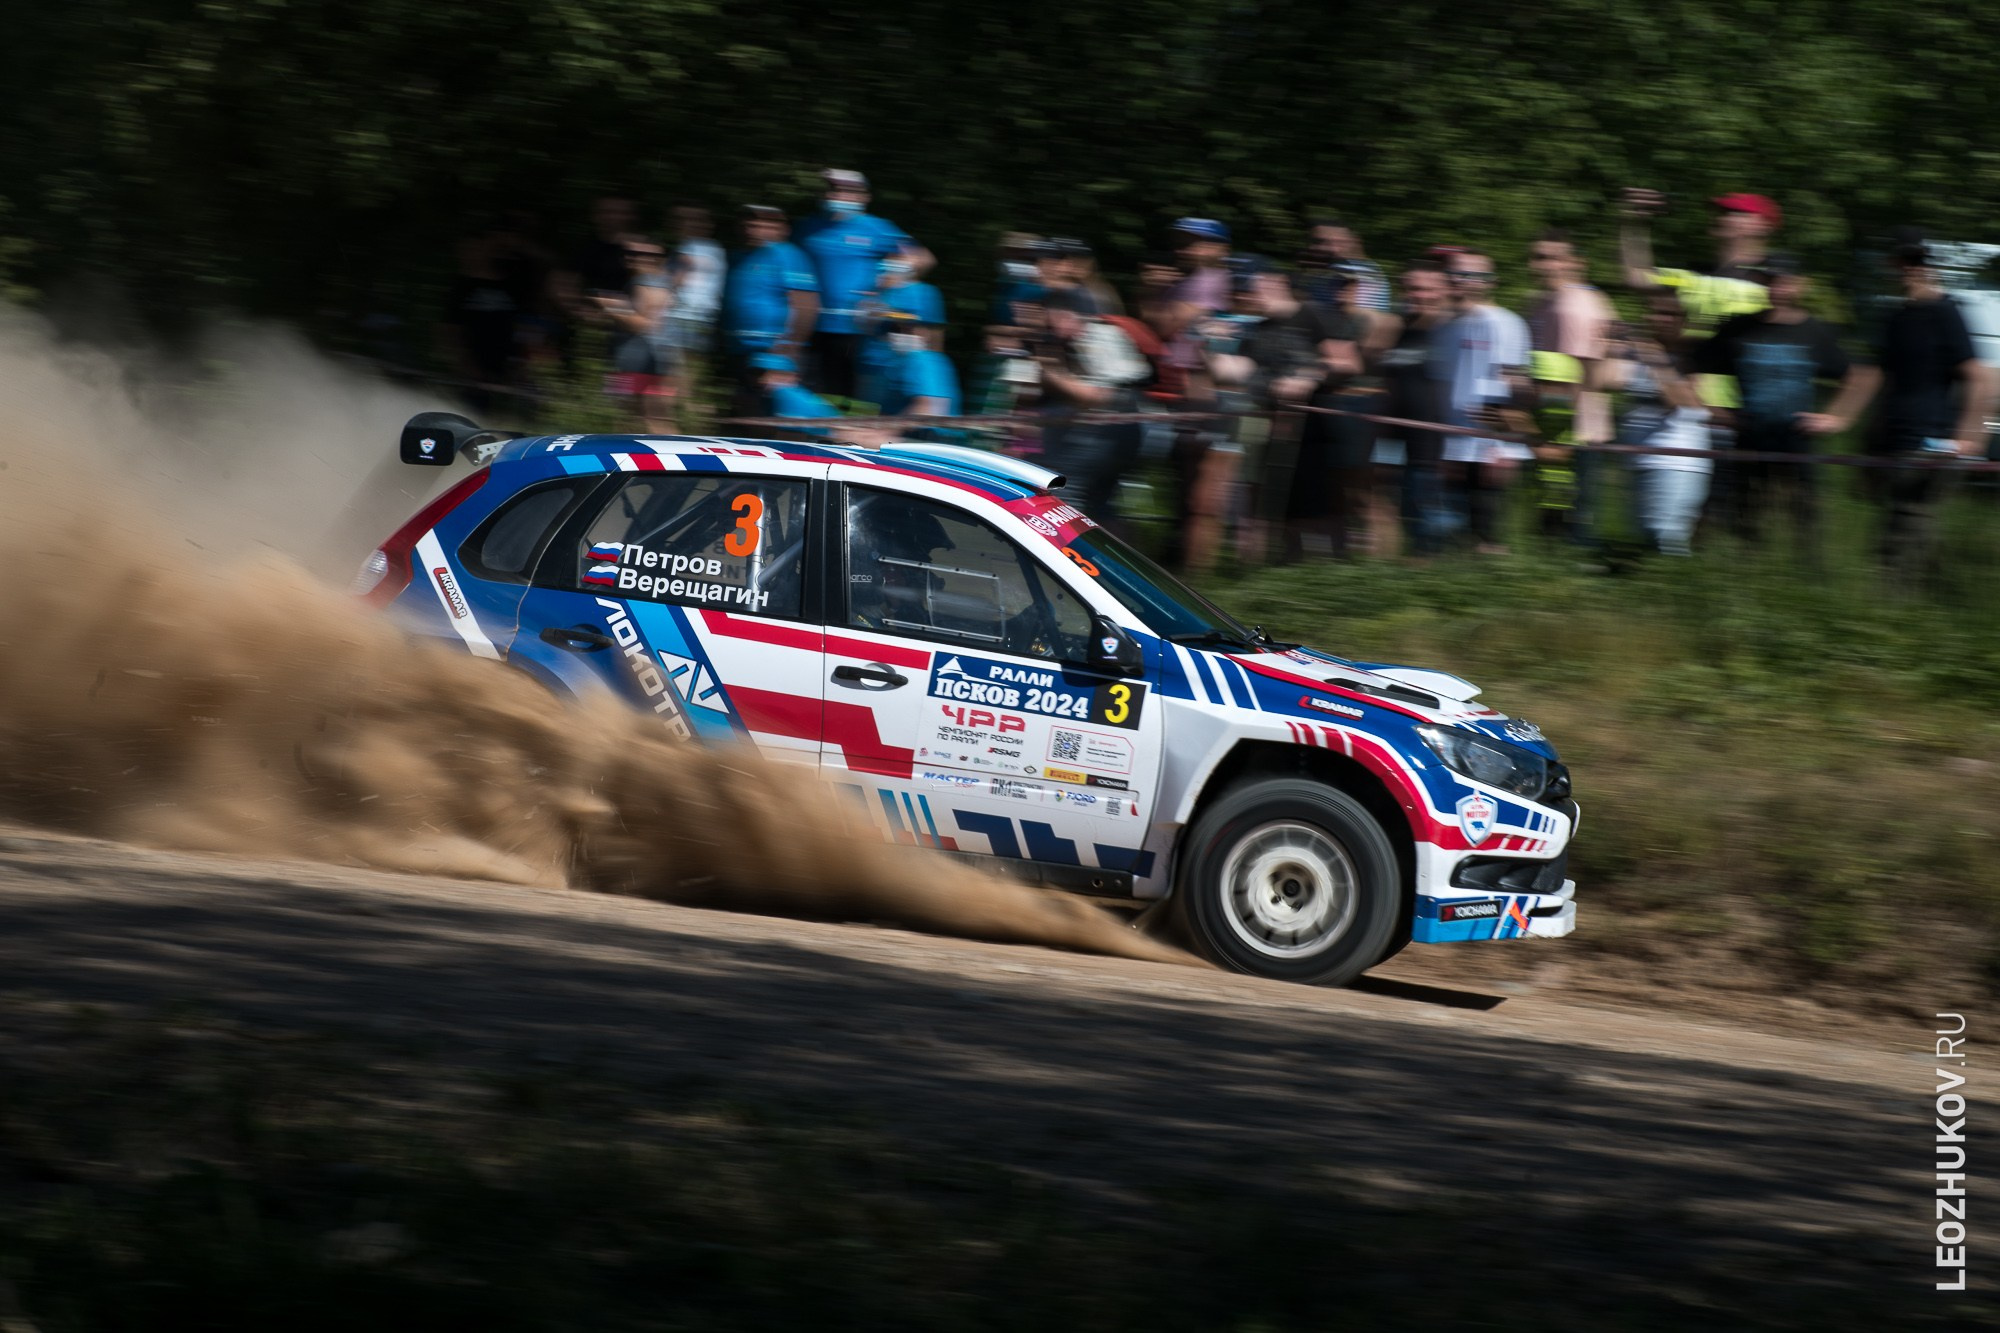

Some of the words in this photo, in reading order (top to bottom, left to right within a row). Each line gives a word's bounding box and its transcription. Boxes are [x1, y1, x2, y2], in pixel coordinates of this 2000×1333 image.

[724, 493, 763, 557] 3
[623, 544, 722, 577] Петров
[1061, 547, 1100, 577] 3
[618, 568, 769, 607] Верещагин
[989, 665, 1054, 688] РАЛЛИ
[934, 677, 1020, 707] ПСКОВ
[1024, 688, 1089, 719] 2024
[1104, 683, 1132, 724] 3
[942, 704, 1026, 733] ЧРР
[937, 733, 949, 741] ПО
[950, 735, 979, 745] РАЛЛИ
[938, 726, 988, 740] ЧЕМПИОНАТ
[990, 734, 1024, 746] РОССИИ
[923, 771, 980, 784] МАСТЕР
